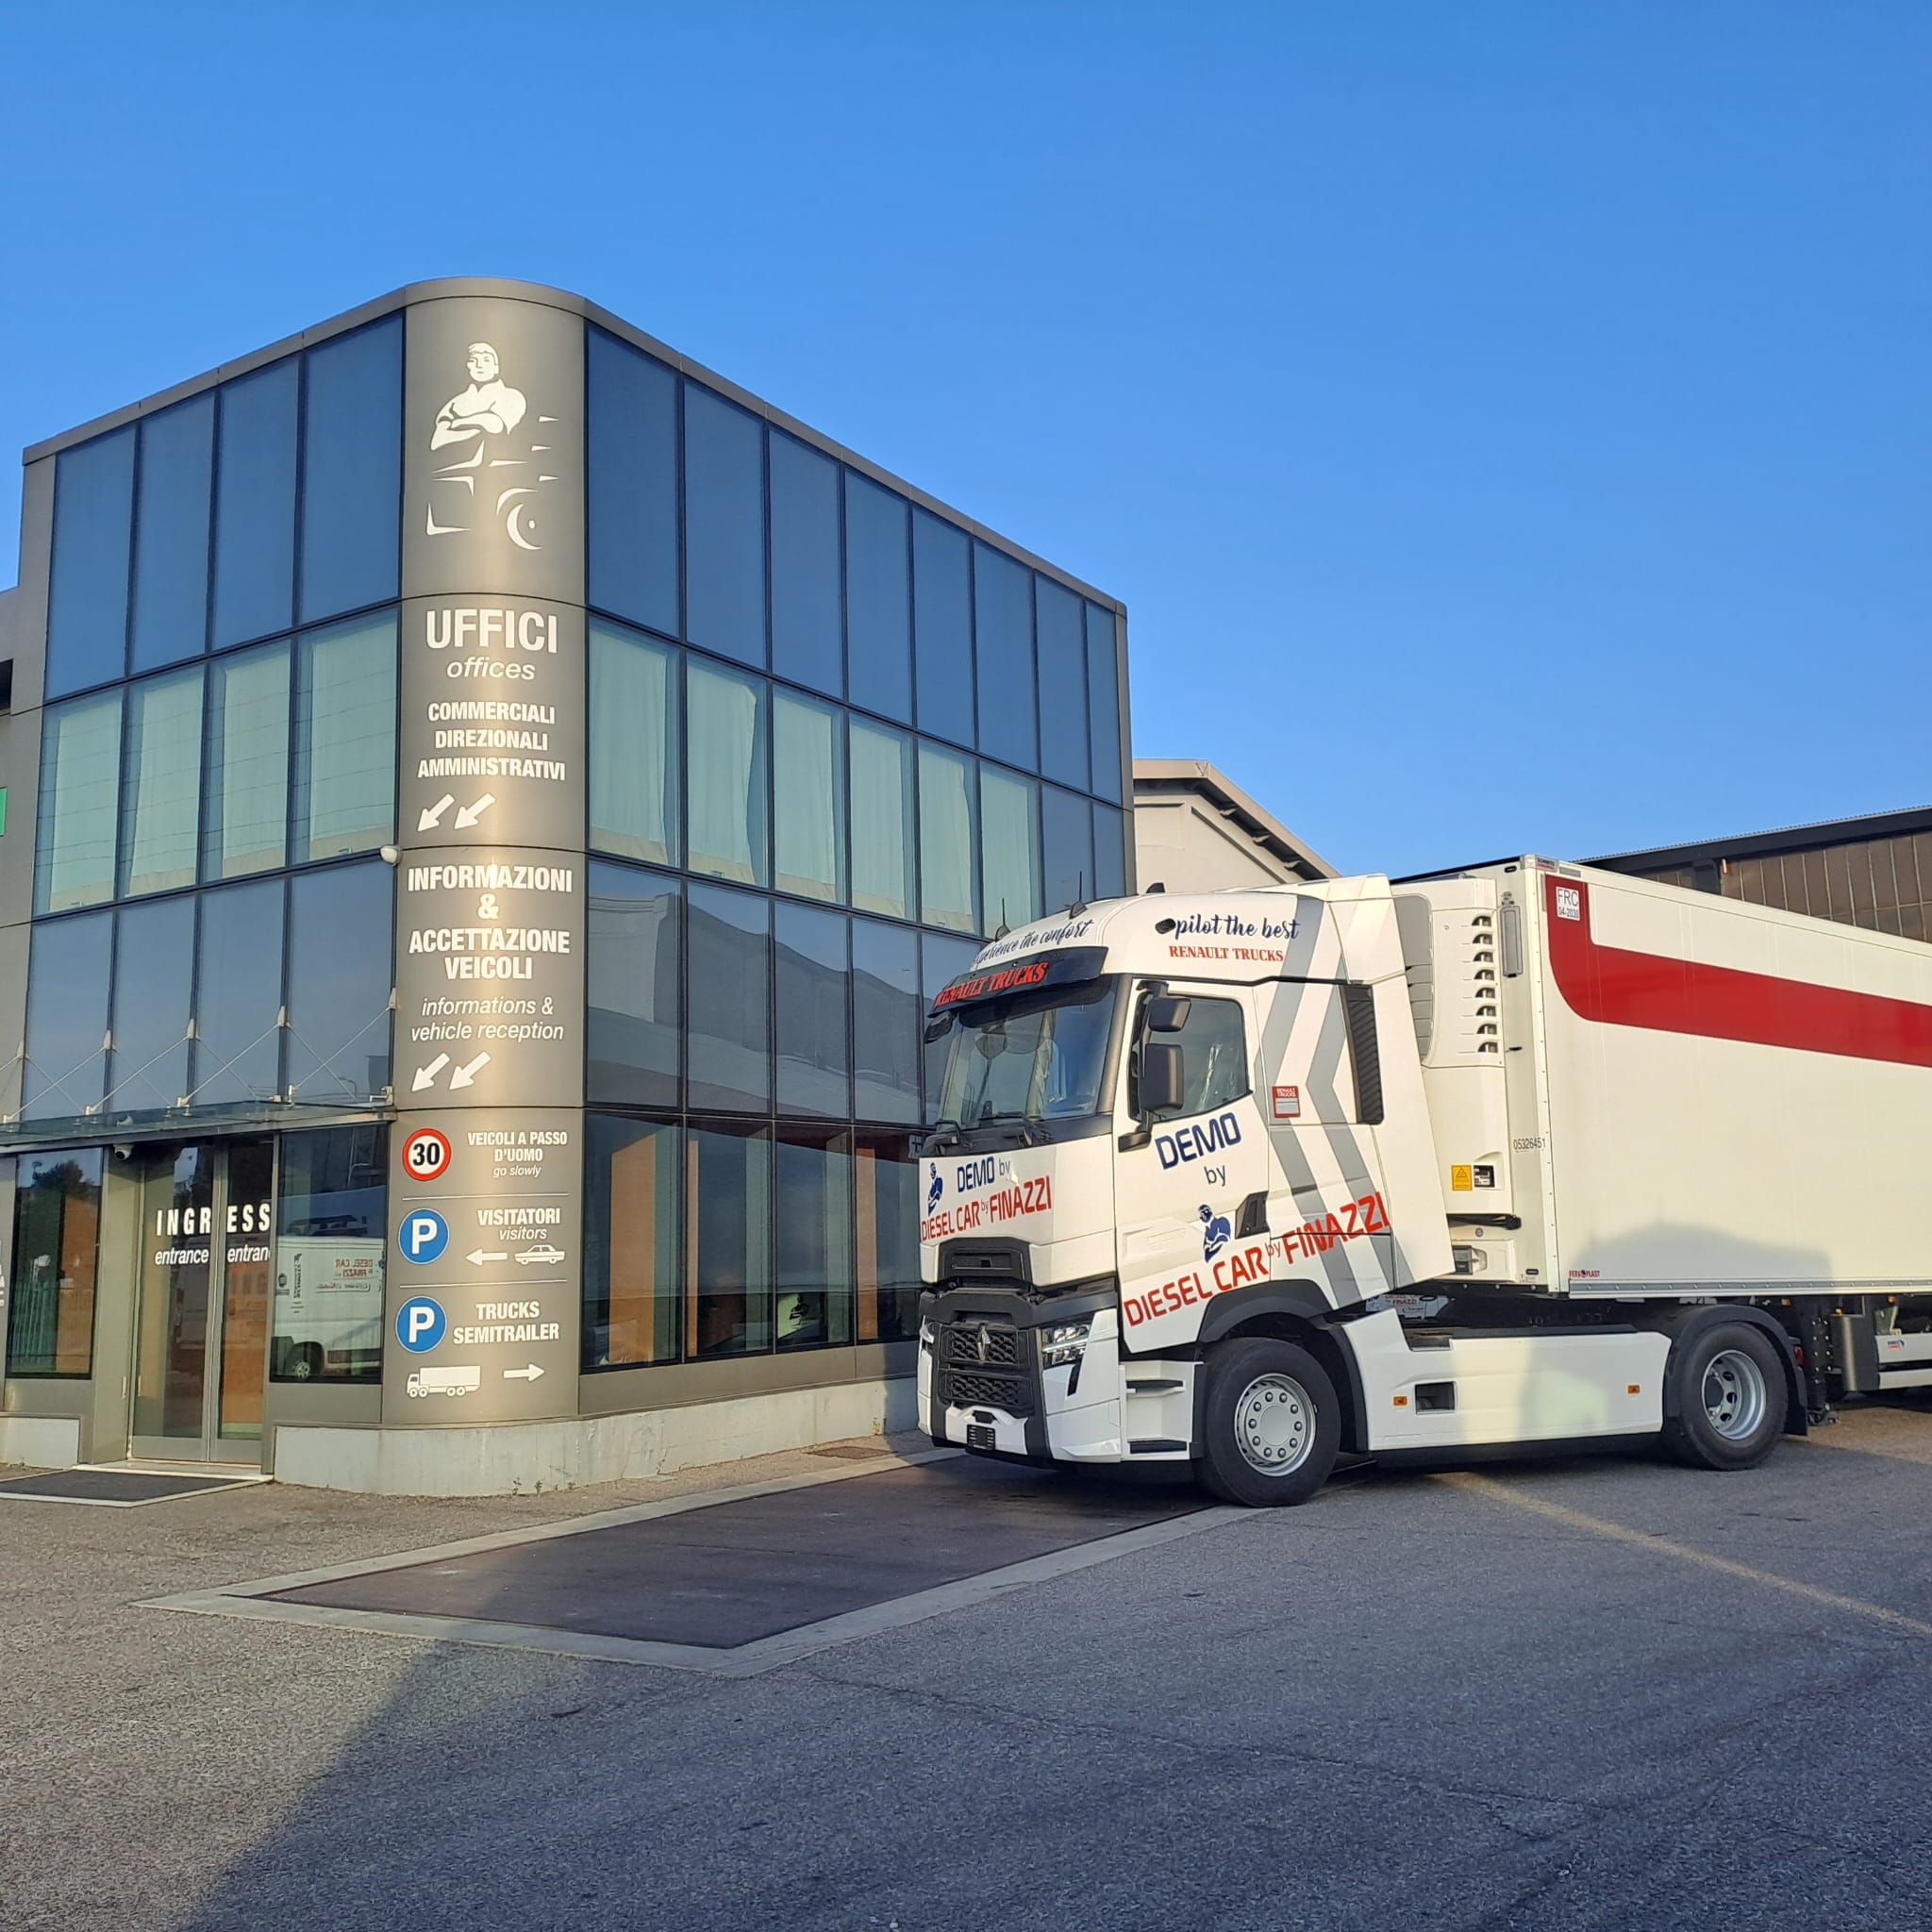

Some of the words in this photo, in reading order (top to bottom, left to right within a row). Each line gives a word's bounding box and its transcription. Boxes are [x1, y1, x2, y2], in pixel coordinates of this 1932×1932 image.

[426, 609, 558, 653] UFFICI
[446, 657, 535, 680] offices
[428, 701, 555, 724] COMMERCIALI
[435, 729, 548, 751] DIREZIONALI
[417, 757, 565, 781] AMMINISTRATIVI
[408, 864, 572, 892] INFORMAZIONI
[477, 893, 498, 920] &
[1557, 889, 1578, 907] FRC
[1174, 913, 1223, 940] pilot
[1223, 915, 1257, 936] the
[1261, 917, 1301, 940] best
[408, 927, 570, 954] ACCETTAZIONE
[1169, 945, 1229, 959] RENAULT
[1232, 948, 1284, 961] TRUCKS
[444, 957, 532, 980] VEICOLI
[935, 975, 988, 1007] RENAULT
[988, 961, 1049, 991] TRUCKS
[422, 996, 536, 1016] informations
[541, 996, 554, 1015] &
[411, 1021, 472, 1041] vehicle
[477, 1022, 564, 1042] reception
[468, 1132, 515, 1146] VEICOLI
[518, 1132, 526, 1145] A
[530, 1131, 568, 1145] PASSO
[1156, 1112, 1241, 1170] DEMO
[1513, 1137, 1545, 1150] 05326451
[412, 1142, 441, 1166] 30
[494, 1148, 543, 1162] D'UOMO
[493, 1166, 507, 1177] go
[509, 1165, 541, 1178] slowly
[957, 1156, 995, 1193] DEMO
[1204, 1164, 1226, 1187] by
[477, 1208, 560, 1225] VISITATORI
[921, 1210, 956, 1241] DIESEL
[956, 1201, 981, 1232] CAR
[981, 1199, 990, 1214] by
[990, 1175, 1052, 1224] FINAZZI
[411, 1218, 438, 1255] P
[499, 1226, 547, 1241] visitors
[155, 1247, 208, 1265] entrance
[1124, 1272, 1213, 1326] DIESEL
[1212, 1246, 1269, 1291] CAR
[1265, 1235, 1284, 1257] by
[1282, 1191, 1391, 1264] FINAZZI
[475, 1301, 540, 1320] TRUCKS
[408, 1306, 435, 1343] P
[453, 1323, 559, 1344] SEMITRAILER
